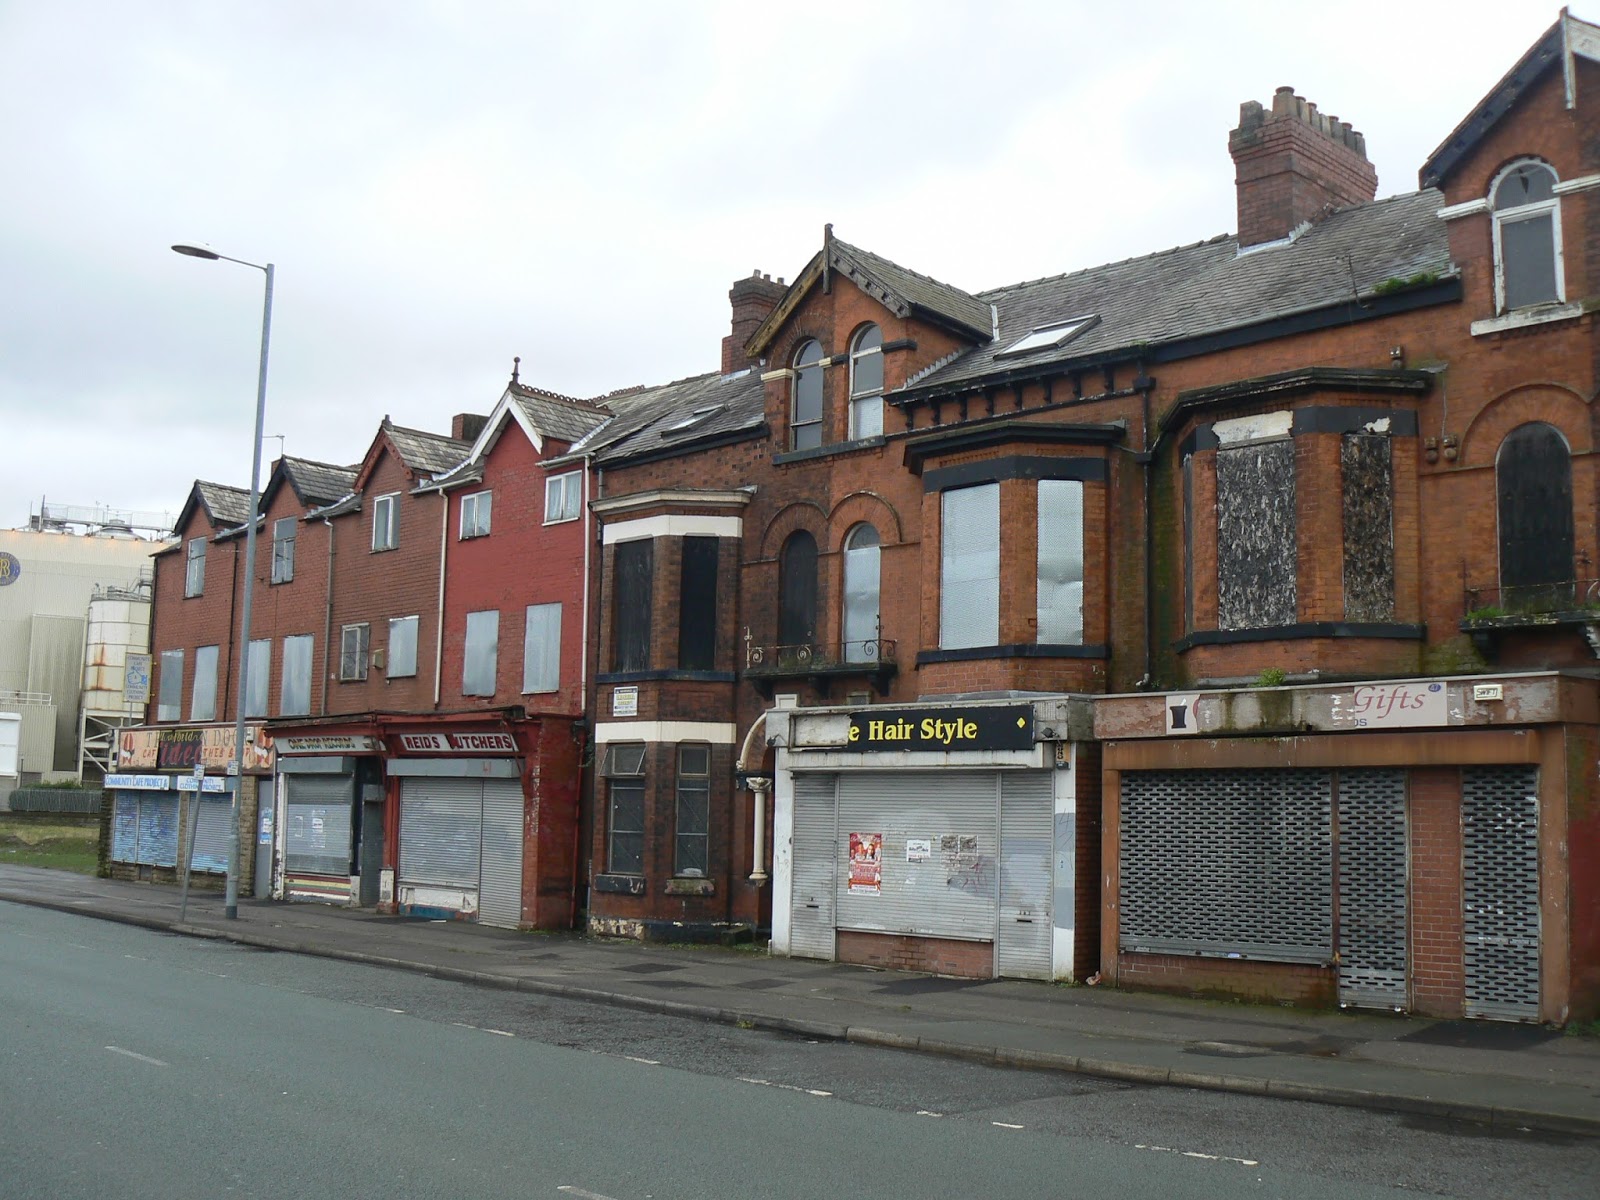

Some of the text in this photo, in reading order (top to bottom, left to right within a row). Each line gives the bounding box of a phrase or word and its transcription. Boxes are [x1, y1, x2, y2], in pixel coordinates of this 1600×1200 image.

[1354, 685, 1426, 719] Gifts
[1476, 687, 1498, 698] SWIFT
[868, 718, 915, 741] Hair
[920, 718, 978, 745] Style
[404, 735, 513, 749] REID'S UTCHERS
